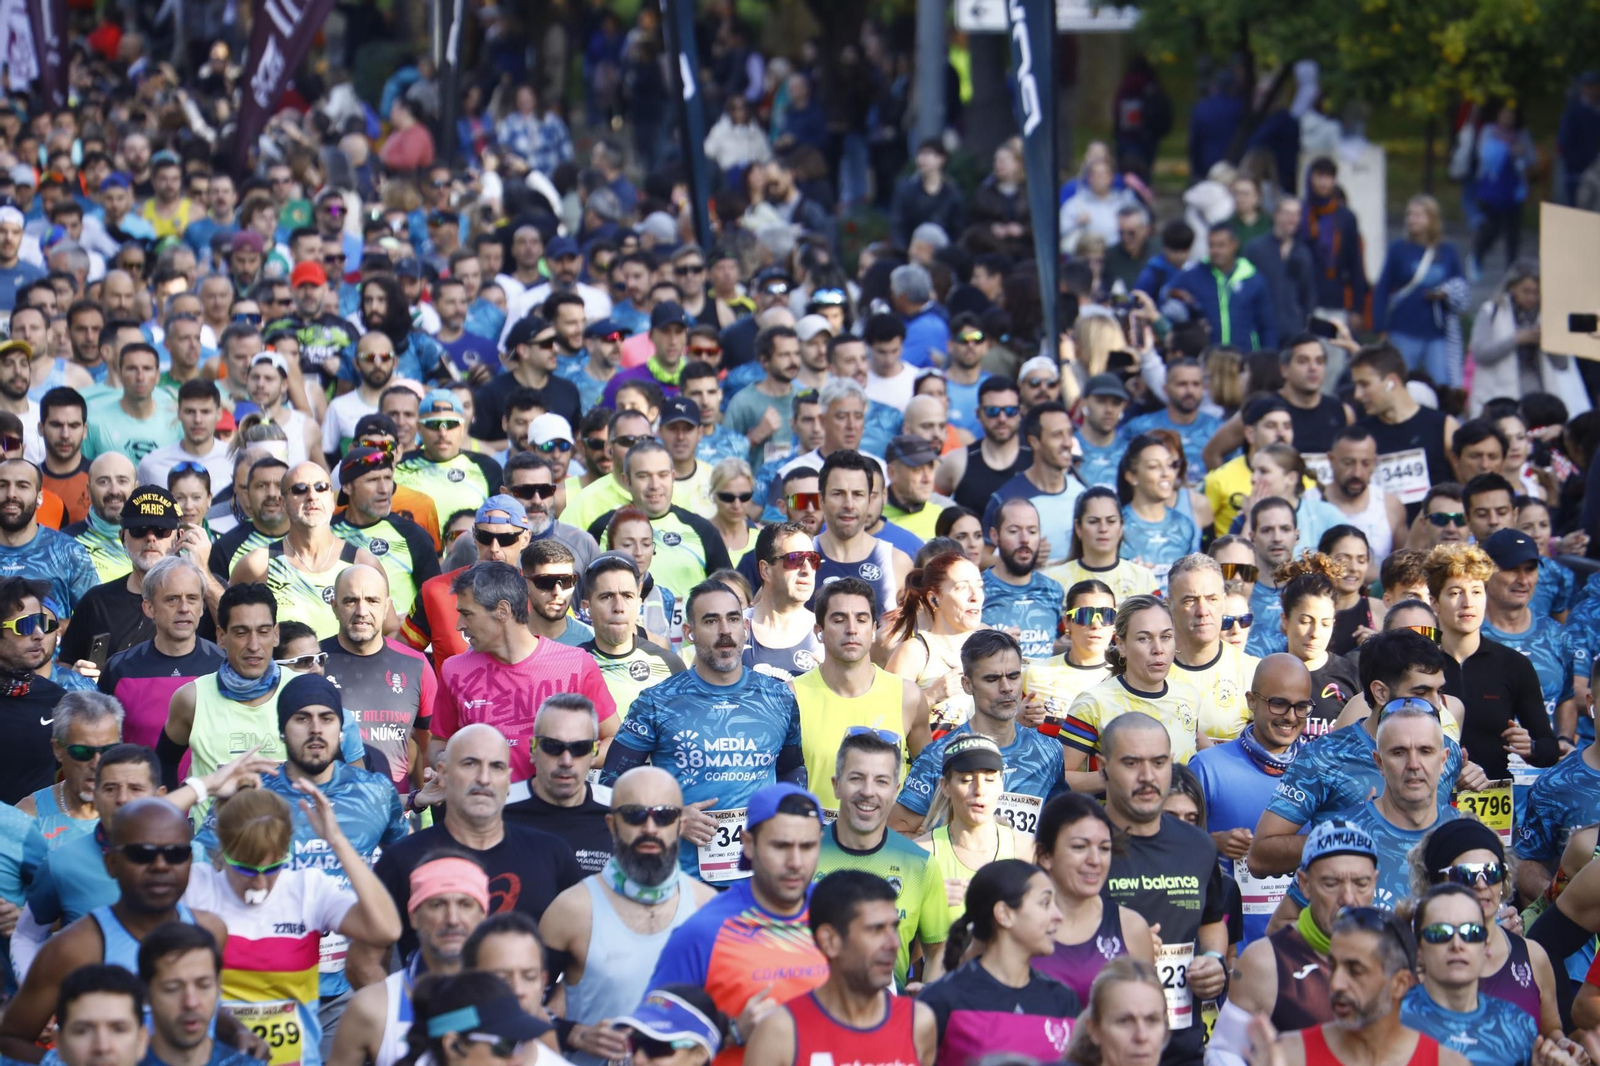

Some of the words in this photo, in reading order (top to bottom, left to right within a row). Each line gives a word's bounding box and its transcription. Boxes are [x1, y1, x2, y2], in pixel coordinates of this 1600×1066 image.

[132, 493, 172, 508] DISNEYLAND
[141, 503, 164, 515] PARIS
[229, 732, 277, 750] FILA
[704, 738, 757, 751] MEDIA
[674, 751, 704, 769] 38
[705, 771, 756, 781] CORDOBA
[1464, 795, 1511, 817] 3796
[1108, 877, 1139, 891] new
[1141, 874, 1199, 890] balance
